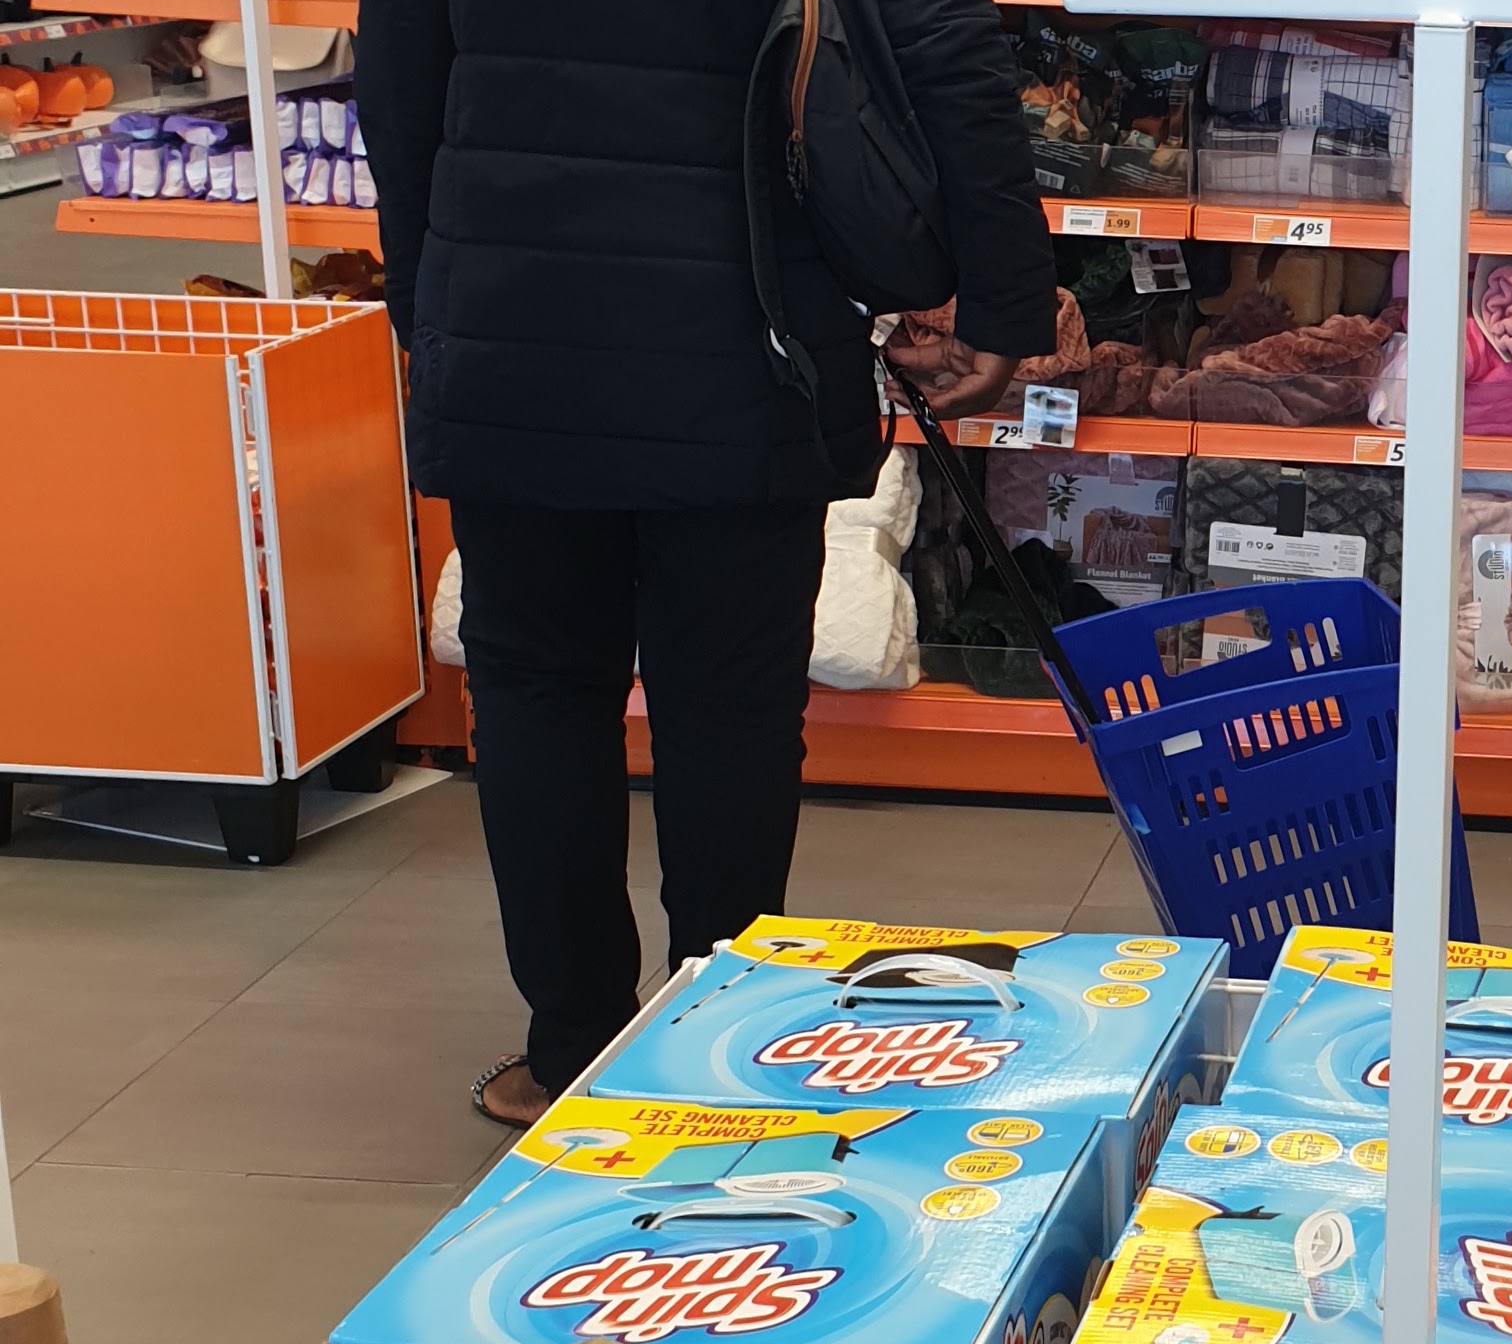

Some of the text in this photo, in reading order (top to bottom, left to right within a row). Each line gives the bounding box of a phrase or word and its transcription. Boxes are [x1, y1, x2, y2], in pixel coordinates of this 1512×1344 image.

[1107, 219, 1130, 229] 1.99
[826, 921, 968, 939] CLEANING SET
[837, 931, 943, 947] COMPLETE
[772, 1021, 950, 1068] mop
[815, 1040, 1004, 1092] Spin
[630, 1108, 796, 1126] CLEANING SET
[640, 1122, 766, 1139] COMPLETE
[527, 1243, 783, 1308] mop
[1103, 1244, 1166, 1331] CLEANING SET
[1144, 1257, 1197, 1323] COMPLETE
[583, 1268, 832, 1341] Spin
